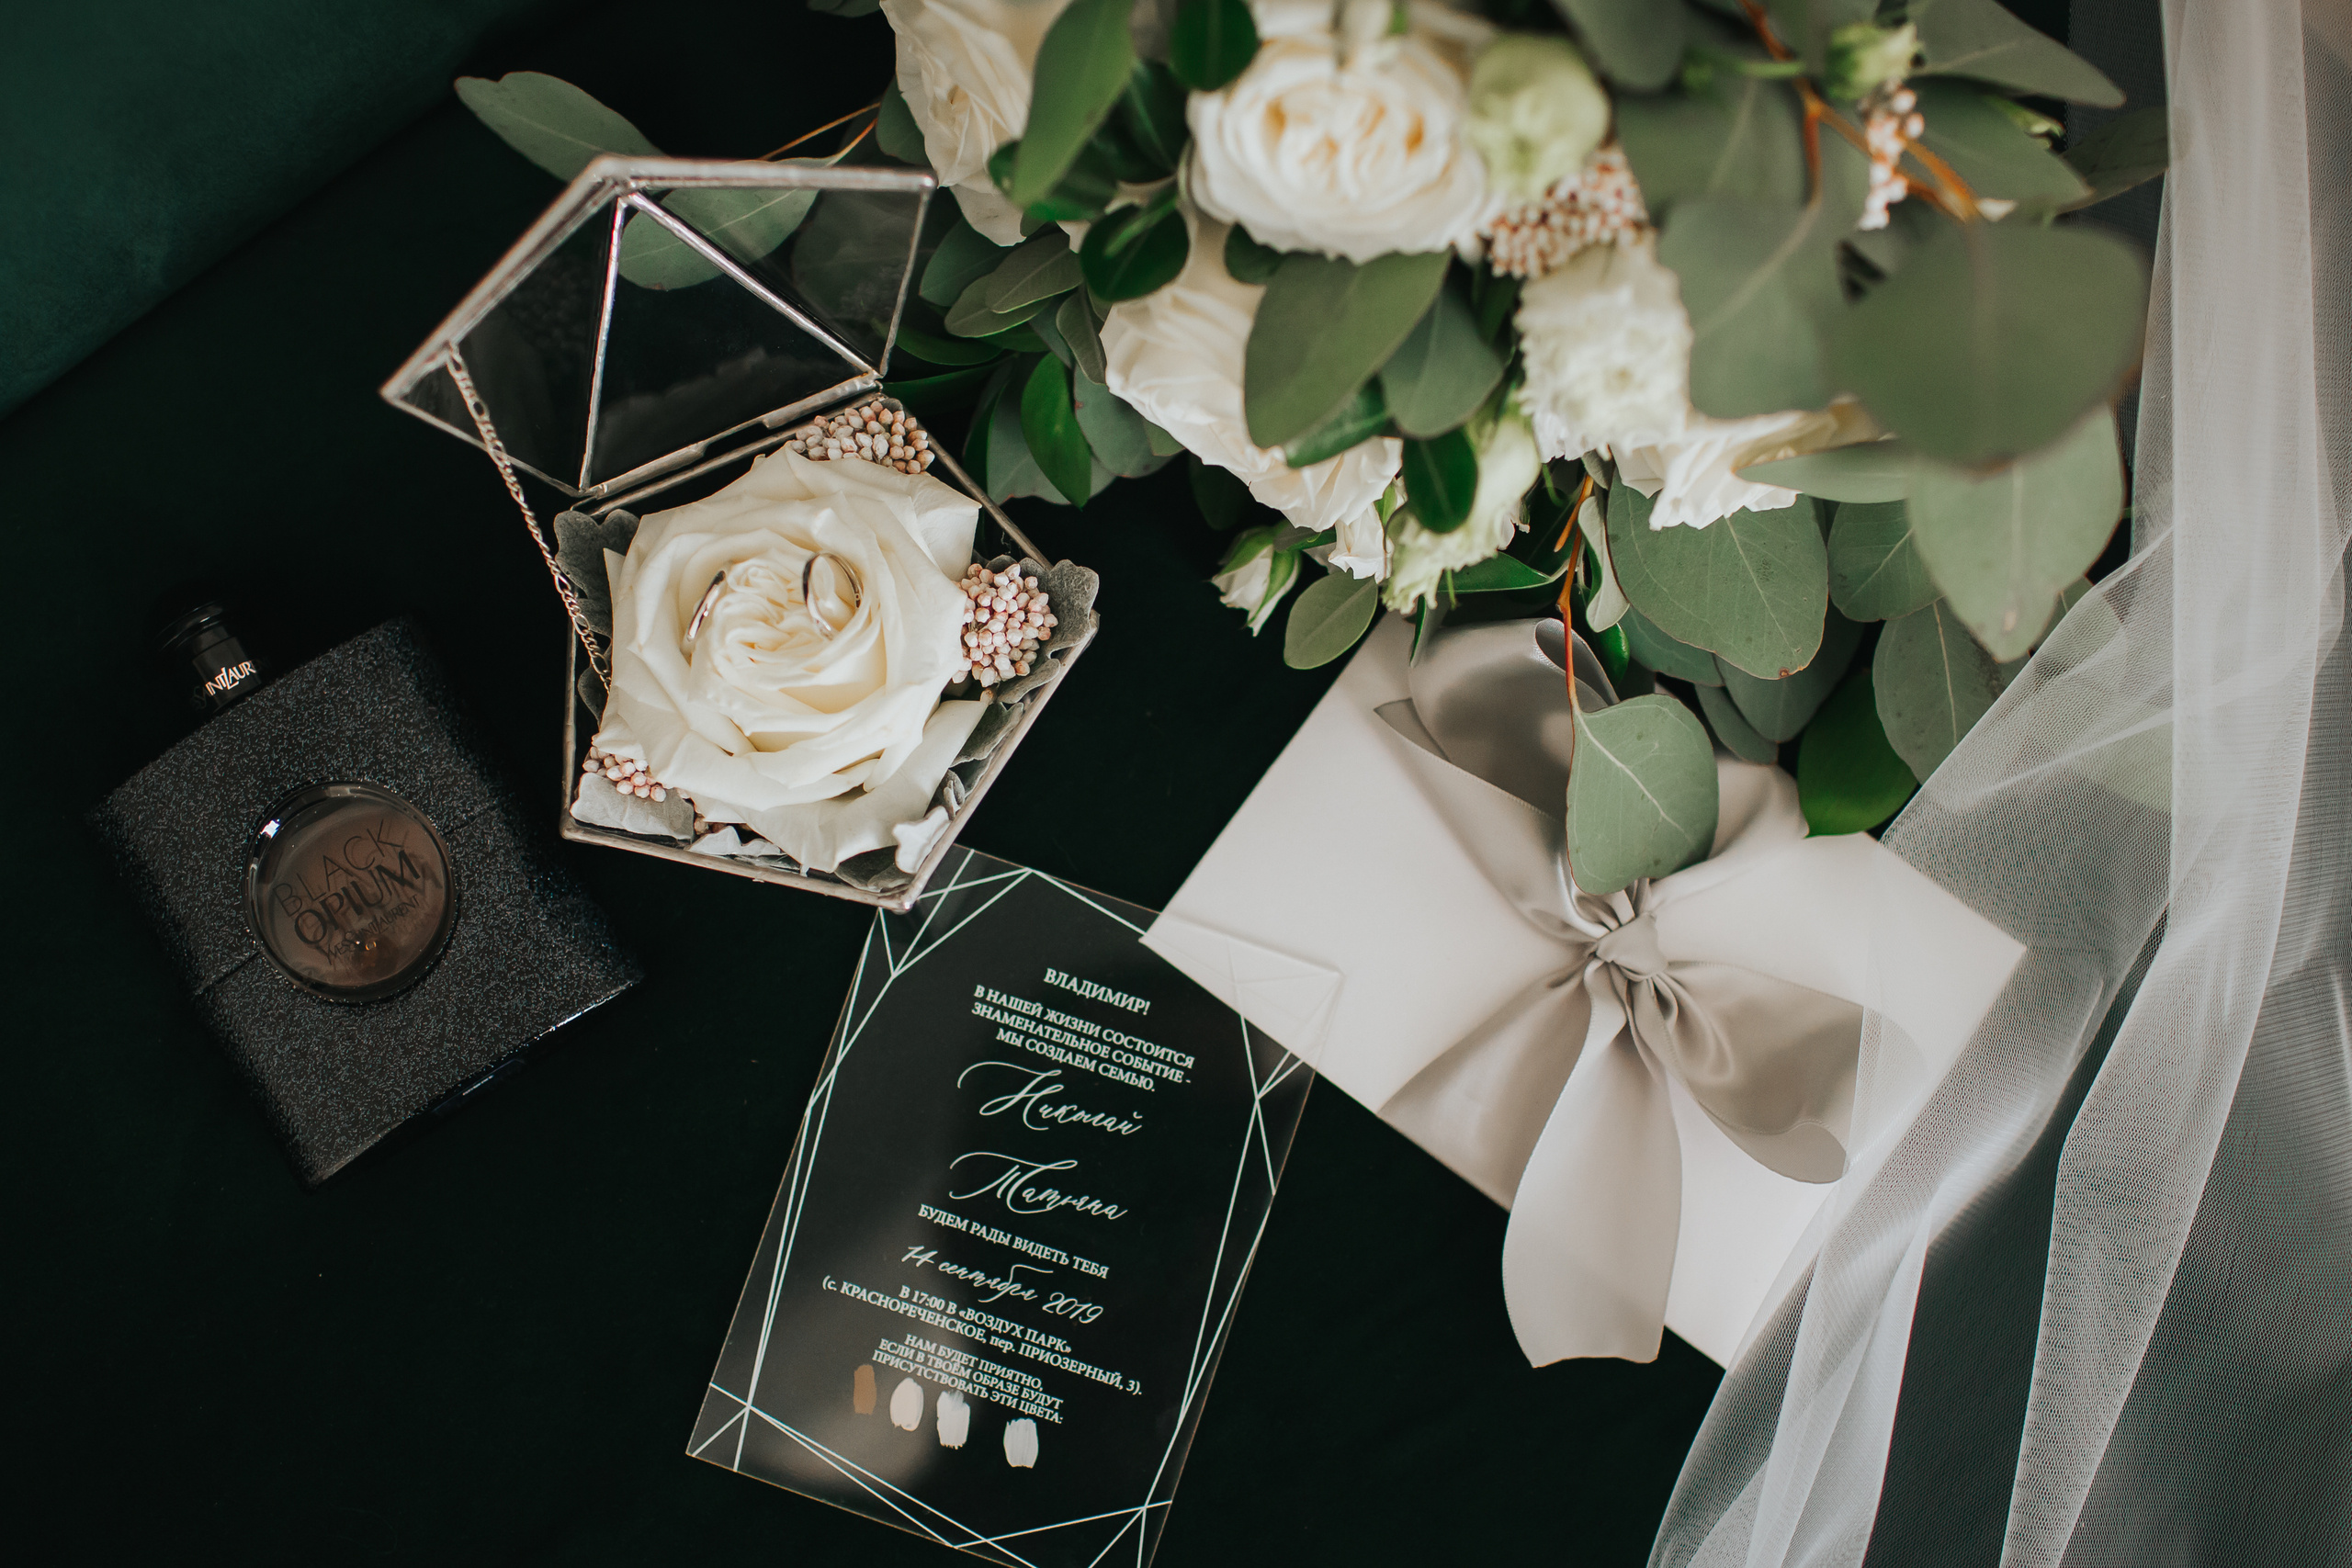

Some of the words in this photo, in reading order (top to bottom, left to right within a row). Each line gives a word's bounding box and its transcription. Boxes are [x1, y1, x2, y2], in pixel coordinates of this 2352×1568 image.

[273, 818, 404, 918] BLACK
[294, 849, 421, 945] OPIUM
[973, 984, 986, 998] В
[985, 988, 1044, 1019] НАШЕЙ
[1043, 1008, 1102, 1038] ЖИЗНИ
[1102, 1029, 1195, 1069] СОСТОИТСЯ
[1043, 967, 1151, 1016] ВЛАДИМИР!
[971, 1001, 1112, 1059] ЗНАМЕНАТЕЛЬНОЕ
[1111, 1049, 1184, 1084] СОБЫТИЕ
[995, 1027, 1025, 1047] МЫ
[1024, 1038, 1098, 1073] СОЗДАЕМ
[1098, 1063, 1156, 1092] СЕМЬЮ.
[956, 1061, 1143, 1135] Николай
[948, 1151, 1128, 1220] Татьяна
[917, 1203, 969, 1232] БУДЕМ
[968, 1221, 1012, 1247] РАДЫ
[1012, 1235, 1069, 1266] ВИДЕТЬ
[1072, 1256, 1110, 1280] ТЕБЯ
[898, 1284, 910, 1299] В
[911, 1290, 945, 1311] 17:00
[945, 1301, 957, 1315] В
[958, 1307, 1025, 1338] «ВОЗДУХ
[1023, 1327, 1072, 1354] ПАРК»
[900, 1246, 938, 1268] 14
[938, 1261, 1054, 1303] сентября
[1042, 1292, 1104, 1324] 2019
[822, 1275, 837, 1292] (с.
[840, 1280, 987, 1344] КРАСНОРЕЧЕНСКОЕ,
[989, 1335, 1016, 1354] пер.
[1018, 1342, 1124, 1391] ПРИОЗЕРНЫЙ,
[1125, 1380, 1142, 1395] 3).
[904, 1334, 938, 1354] НАМ
[936, 1345, 979, 1368] БУДЕТ
[978, 1359, 1044, 1393] ПРИЯТНО,
[872, 1349, 989, 1399] ПРИСУТСТВОВАТЬ
[989, 1390, 1019, 1409] ЭТИ
[1018, 1399, 1064, 1425] ЦВЕТА:
[878, 1337, 916, 1360] ЕСЛИ
[915, 1350, 925, 1363] В
[972, 1371, 1021, 1396] ОБРАЗЕ
[1020, 1386, 1064, 1410] БУДУТ
